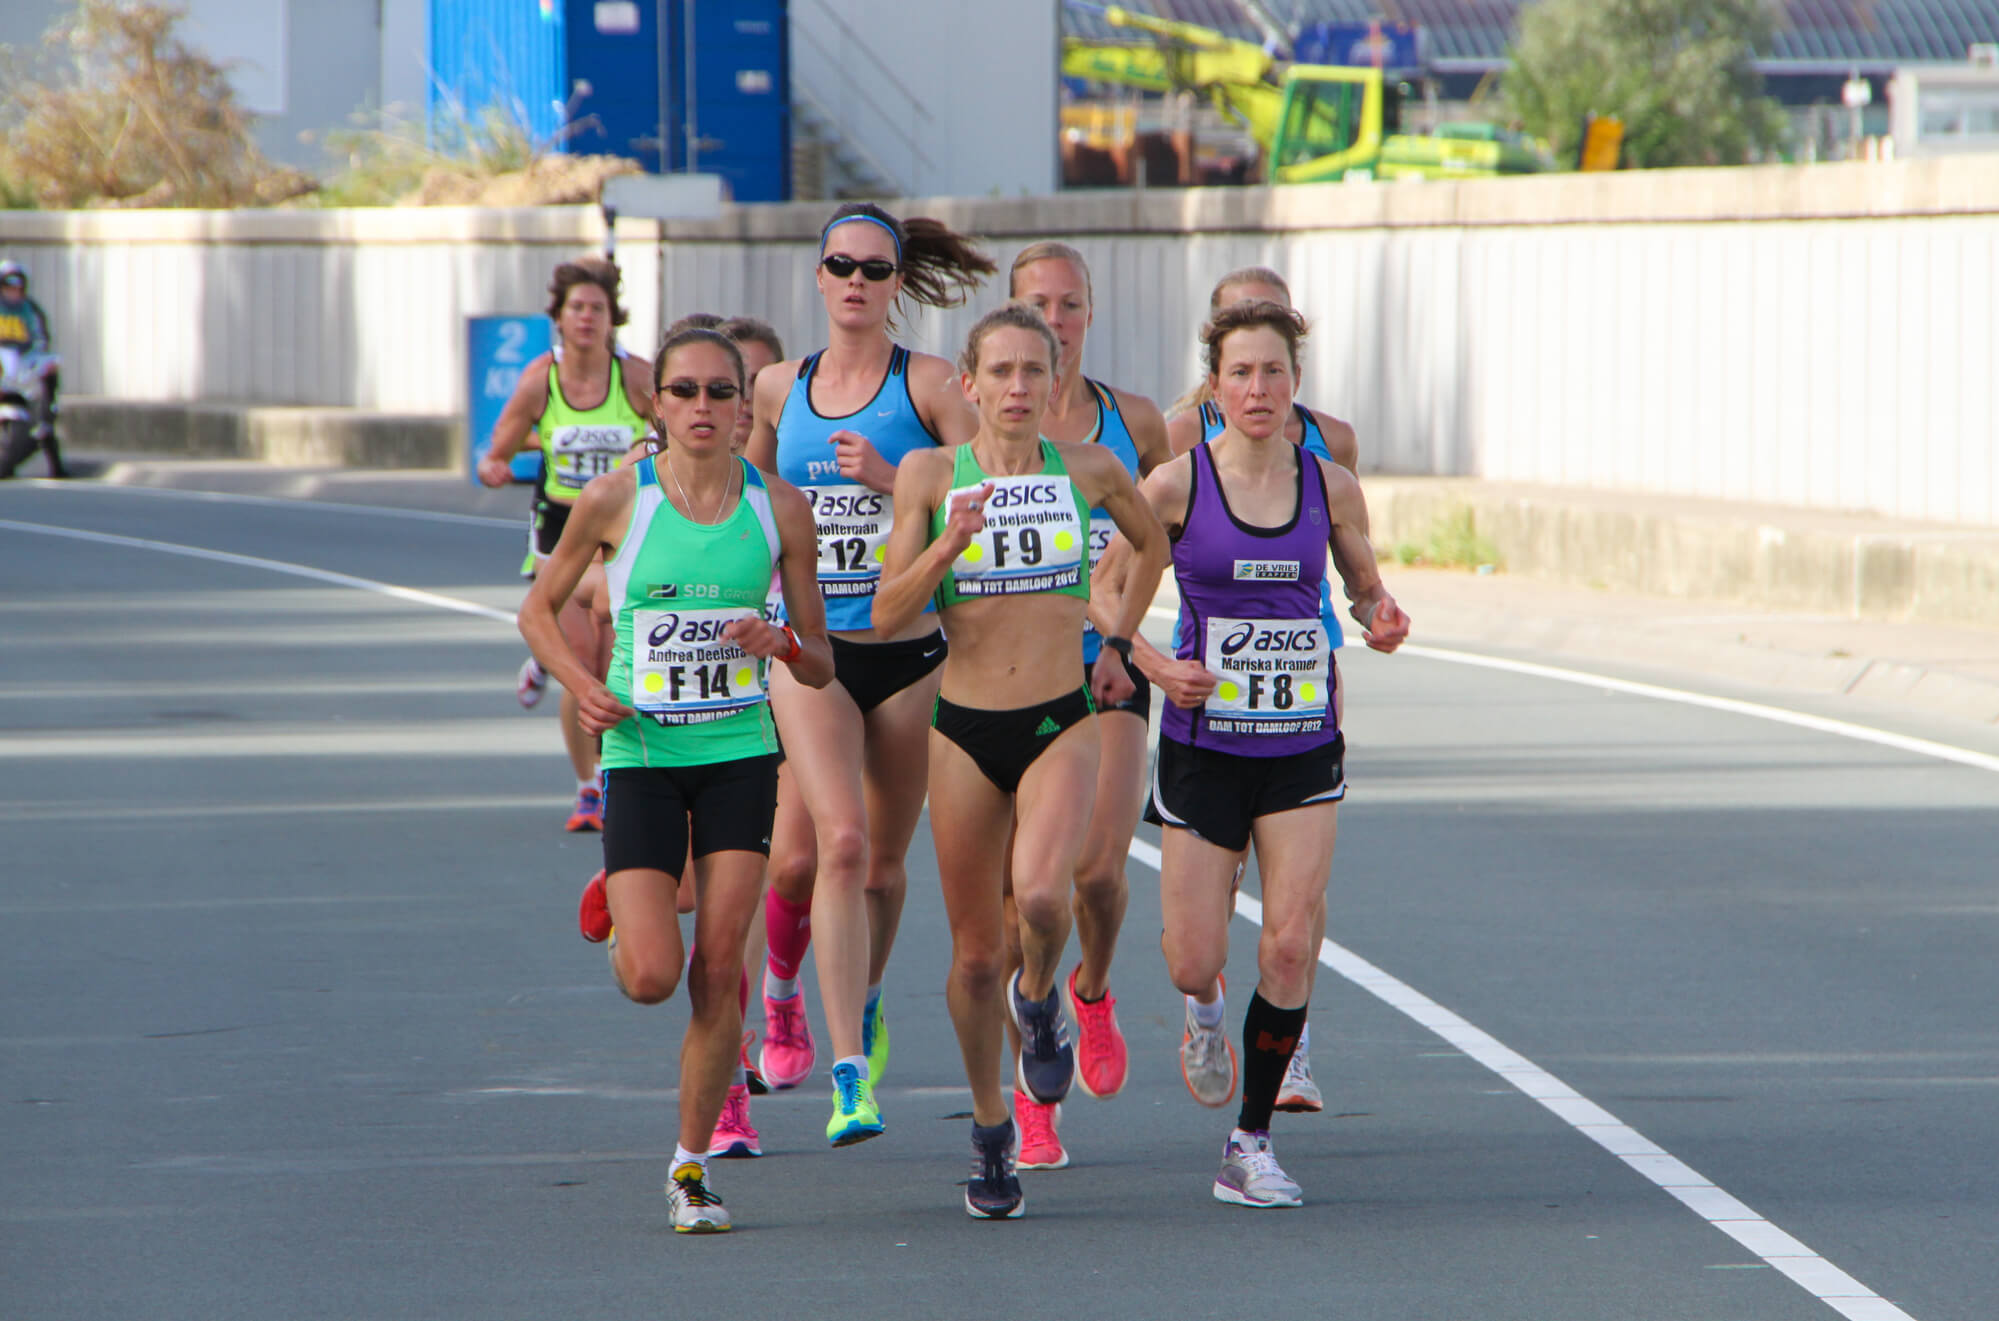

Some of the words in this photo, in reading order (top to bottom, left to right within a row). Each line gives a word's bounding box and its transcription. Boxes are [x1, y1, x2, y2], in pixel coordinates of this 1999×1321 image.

[494, 321, 527, 363] 2
[575, 452, 584, 474] F
[806, 461, 840, 480] pw
[819, 495, 883, 516] asics
[992, 484, 1057, 508] asics
[816, 523, 879, 536] Holterman
[999, 510, 1073, 528] Dejaeghere
[829, 537, 868, 571] 12
[993, 530, 1010, 568] F
[1019, 527, 1042, 566] 9
[684, 583, 720, 598] SDB
[825, 582, 873, 594] DAMLOOP
[959, 579, 982, 593] DAM
[983, 580, 1003, 593] TOT
[1005, 575, 1054, 592] DAMLOOP
[1055, 569, 1079, 587] 2012
[680, 619, 743, 642] asic
[1254, 629, 1317, 651] asics
[648, 649, 693, 662] Andrea
[696, 646, 746, 662] Deelstra
[1221, 657, 1272, 671] Mariska
[1275, 658, 1318, 671] Kramer
[669, 666, 685, 701] F
[694, 664, 730, 699] 14
[1248, 674, 1265, 709] F
[1273, 674, 1293, 710] 8
[1208, 720, 1233, 731] DAM
[1234, 721, 1254, 733] TOT
[1255, 721, 1301, 733] DAMLOOP
[1302, 720, 1322, 732] 2012
